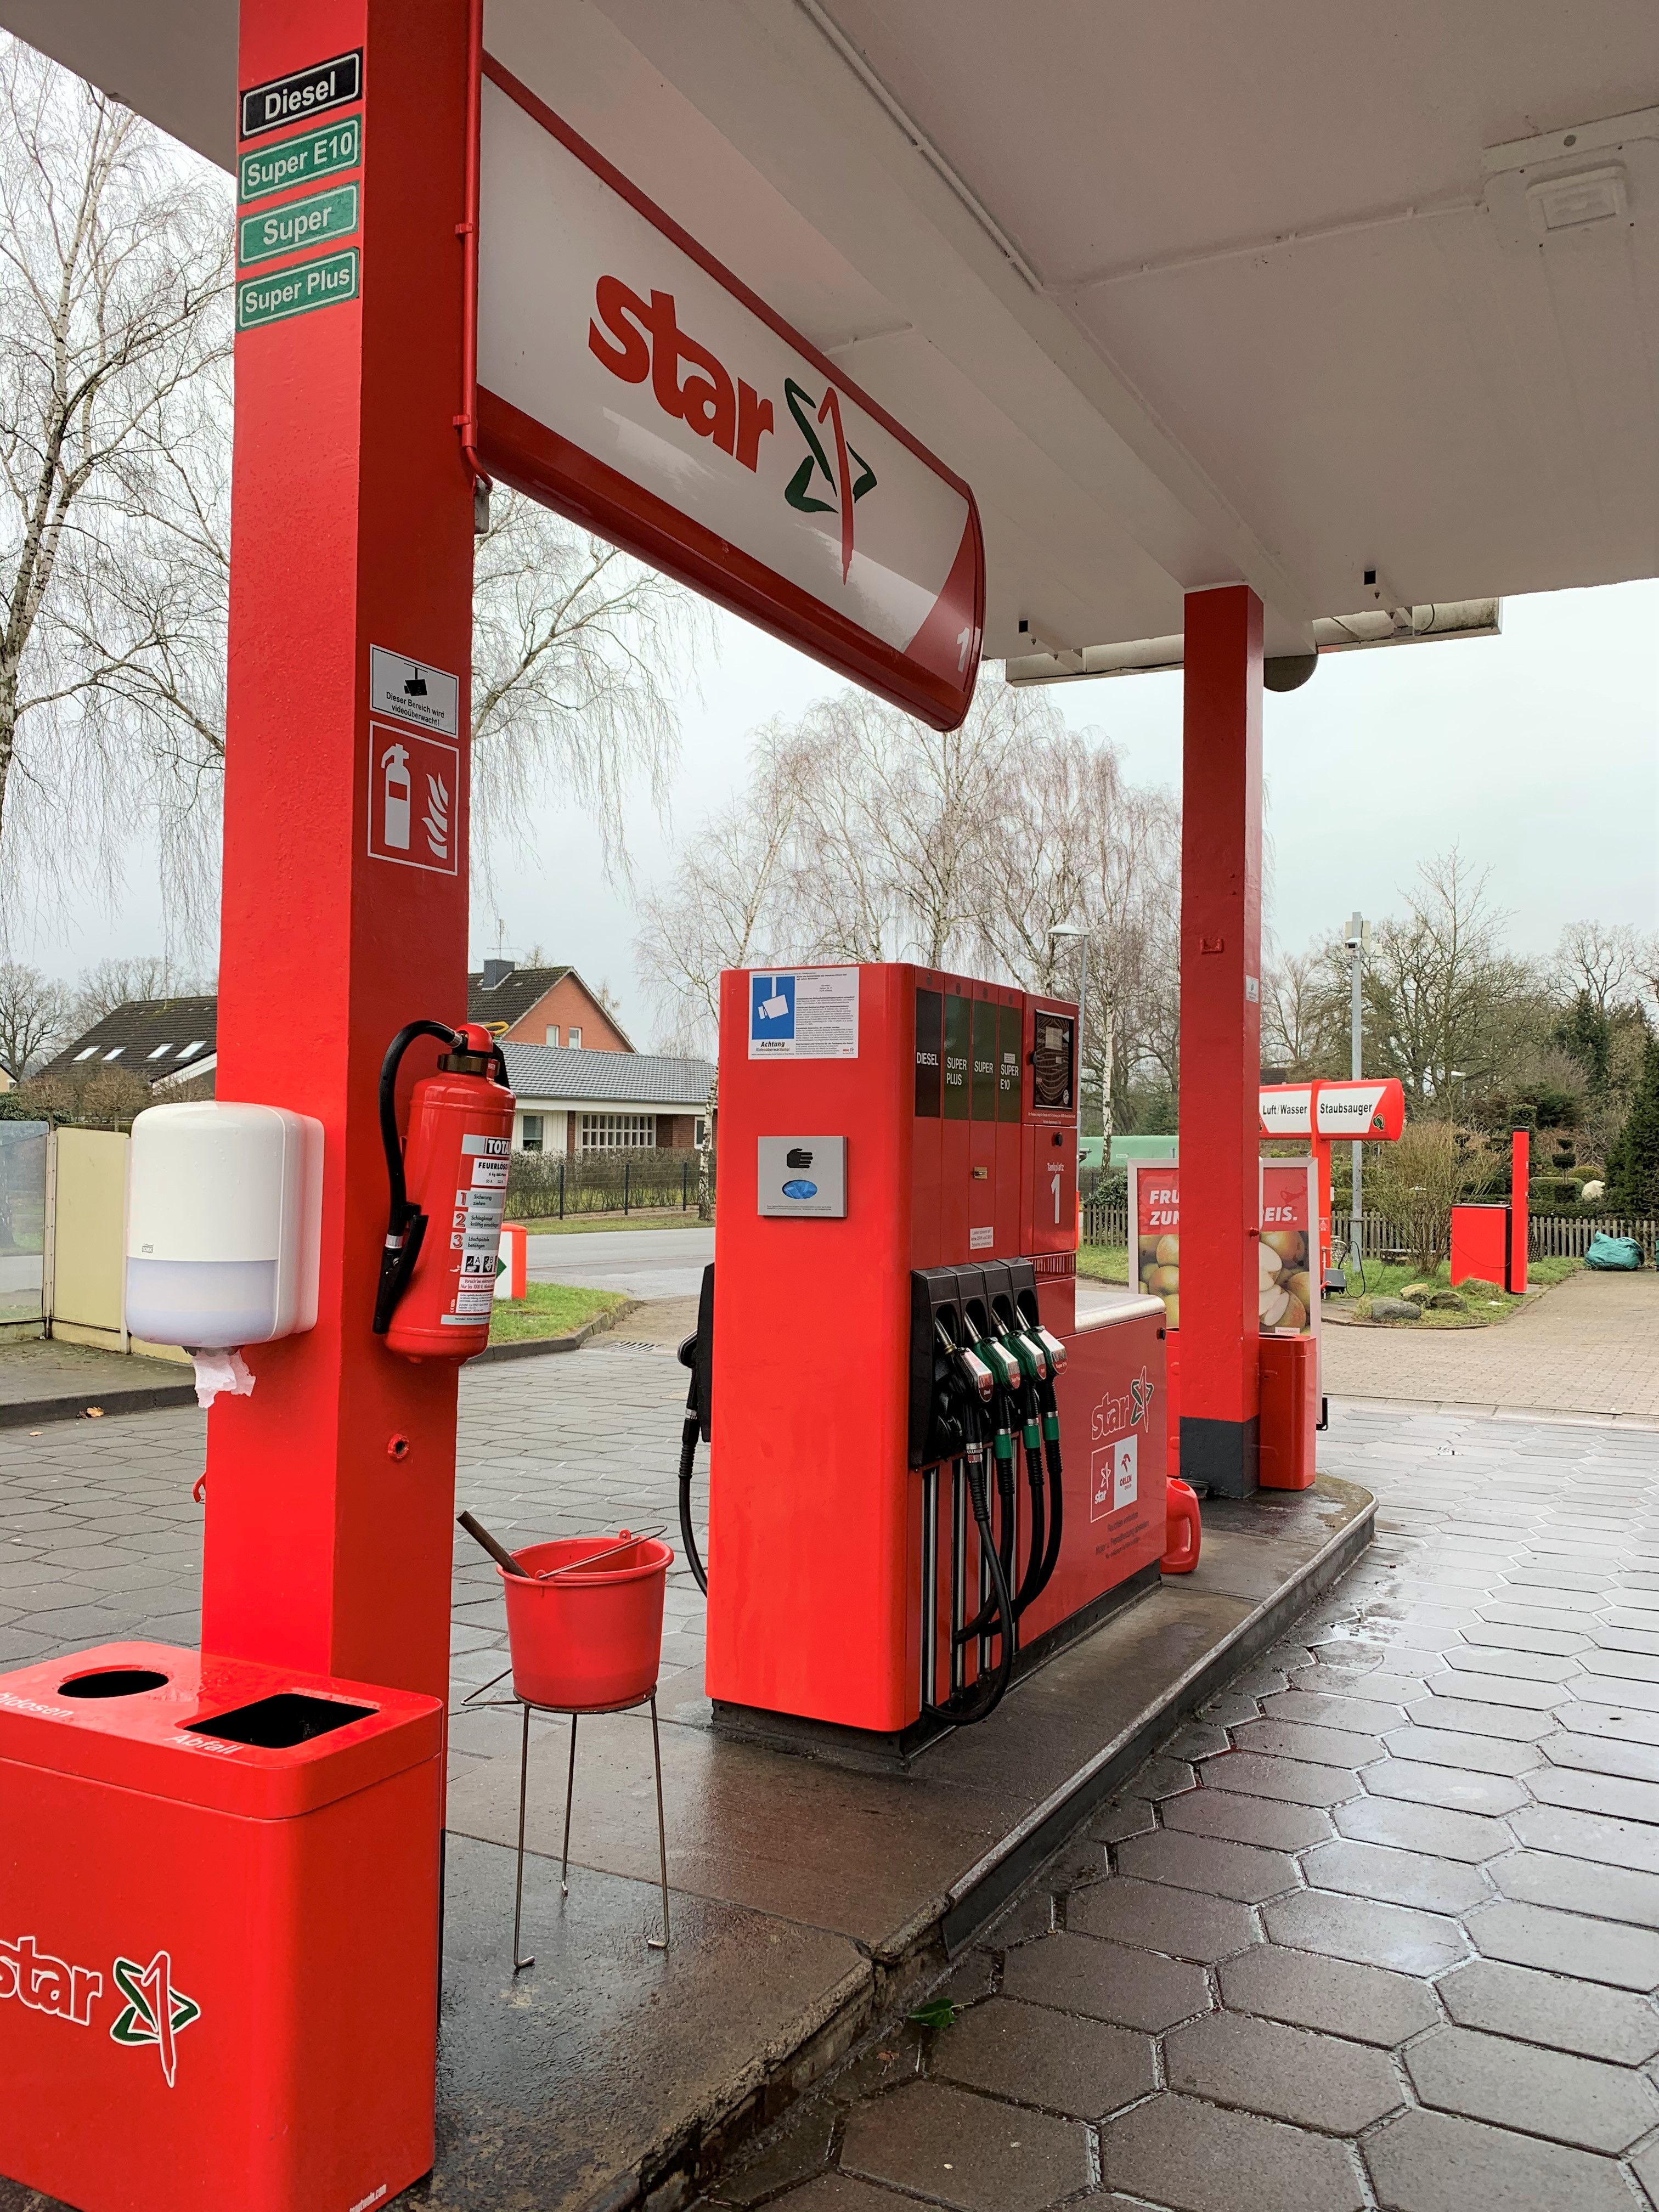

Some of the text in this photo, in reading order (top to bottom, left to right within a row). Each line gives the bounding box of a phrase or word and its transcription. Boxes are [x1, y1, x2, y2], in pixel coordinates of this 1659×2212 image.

[264, 71, 336, 120] Diesel
[247, 132, 352, 187] Super E10
[263, 206, 332, 245] Super
[245, 268, 350, 313] Super Plus
[588, 275, 774, 473] star
[957, 627, 970, 673] 1
[386, 691, 444, 719] Dieser Bereich wird
[392, 704, 439, 726] videoüberwacht!
[917, 1052, 939, 1066] DIESEL
[947, 1057, 967, 1070] SUPER
[974, 1060, 994, 1074] SUPER
[1001, 1064, 1019, 1076] SUPER
[946, 1073, 962, 1086] PLUS
[1000, 1079, 1011, 1090] E10
[1320, 1103, 1373, 1116] Staubsauger
[1047, 1162, 1064, 1173] Tankplatz
[461, 1192, 467, 1205] 1
[1051, 1174, 1060, 1223] 1
[1150, 1189, 1179, 1204] FRU
[455, 1213, 466, 1227] 2
[1264, 1206, 1297, 1222] EIS.
[453, 1234, 462, 1248] 3
[1092, 1391, 1129, 1440] star
[1120, 1475, 1132, 1486] ORLEN
[1094, 1489, 1107, 1504] star
[163, 1735, 245, 1754] Abfall
